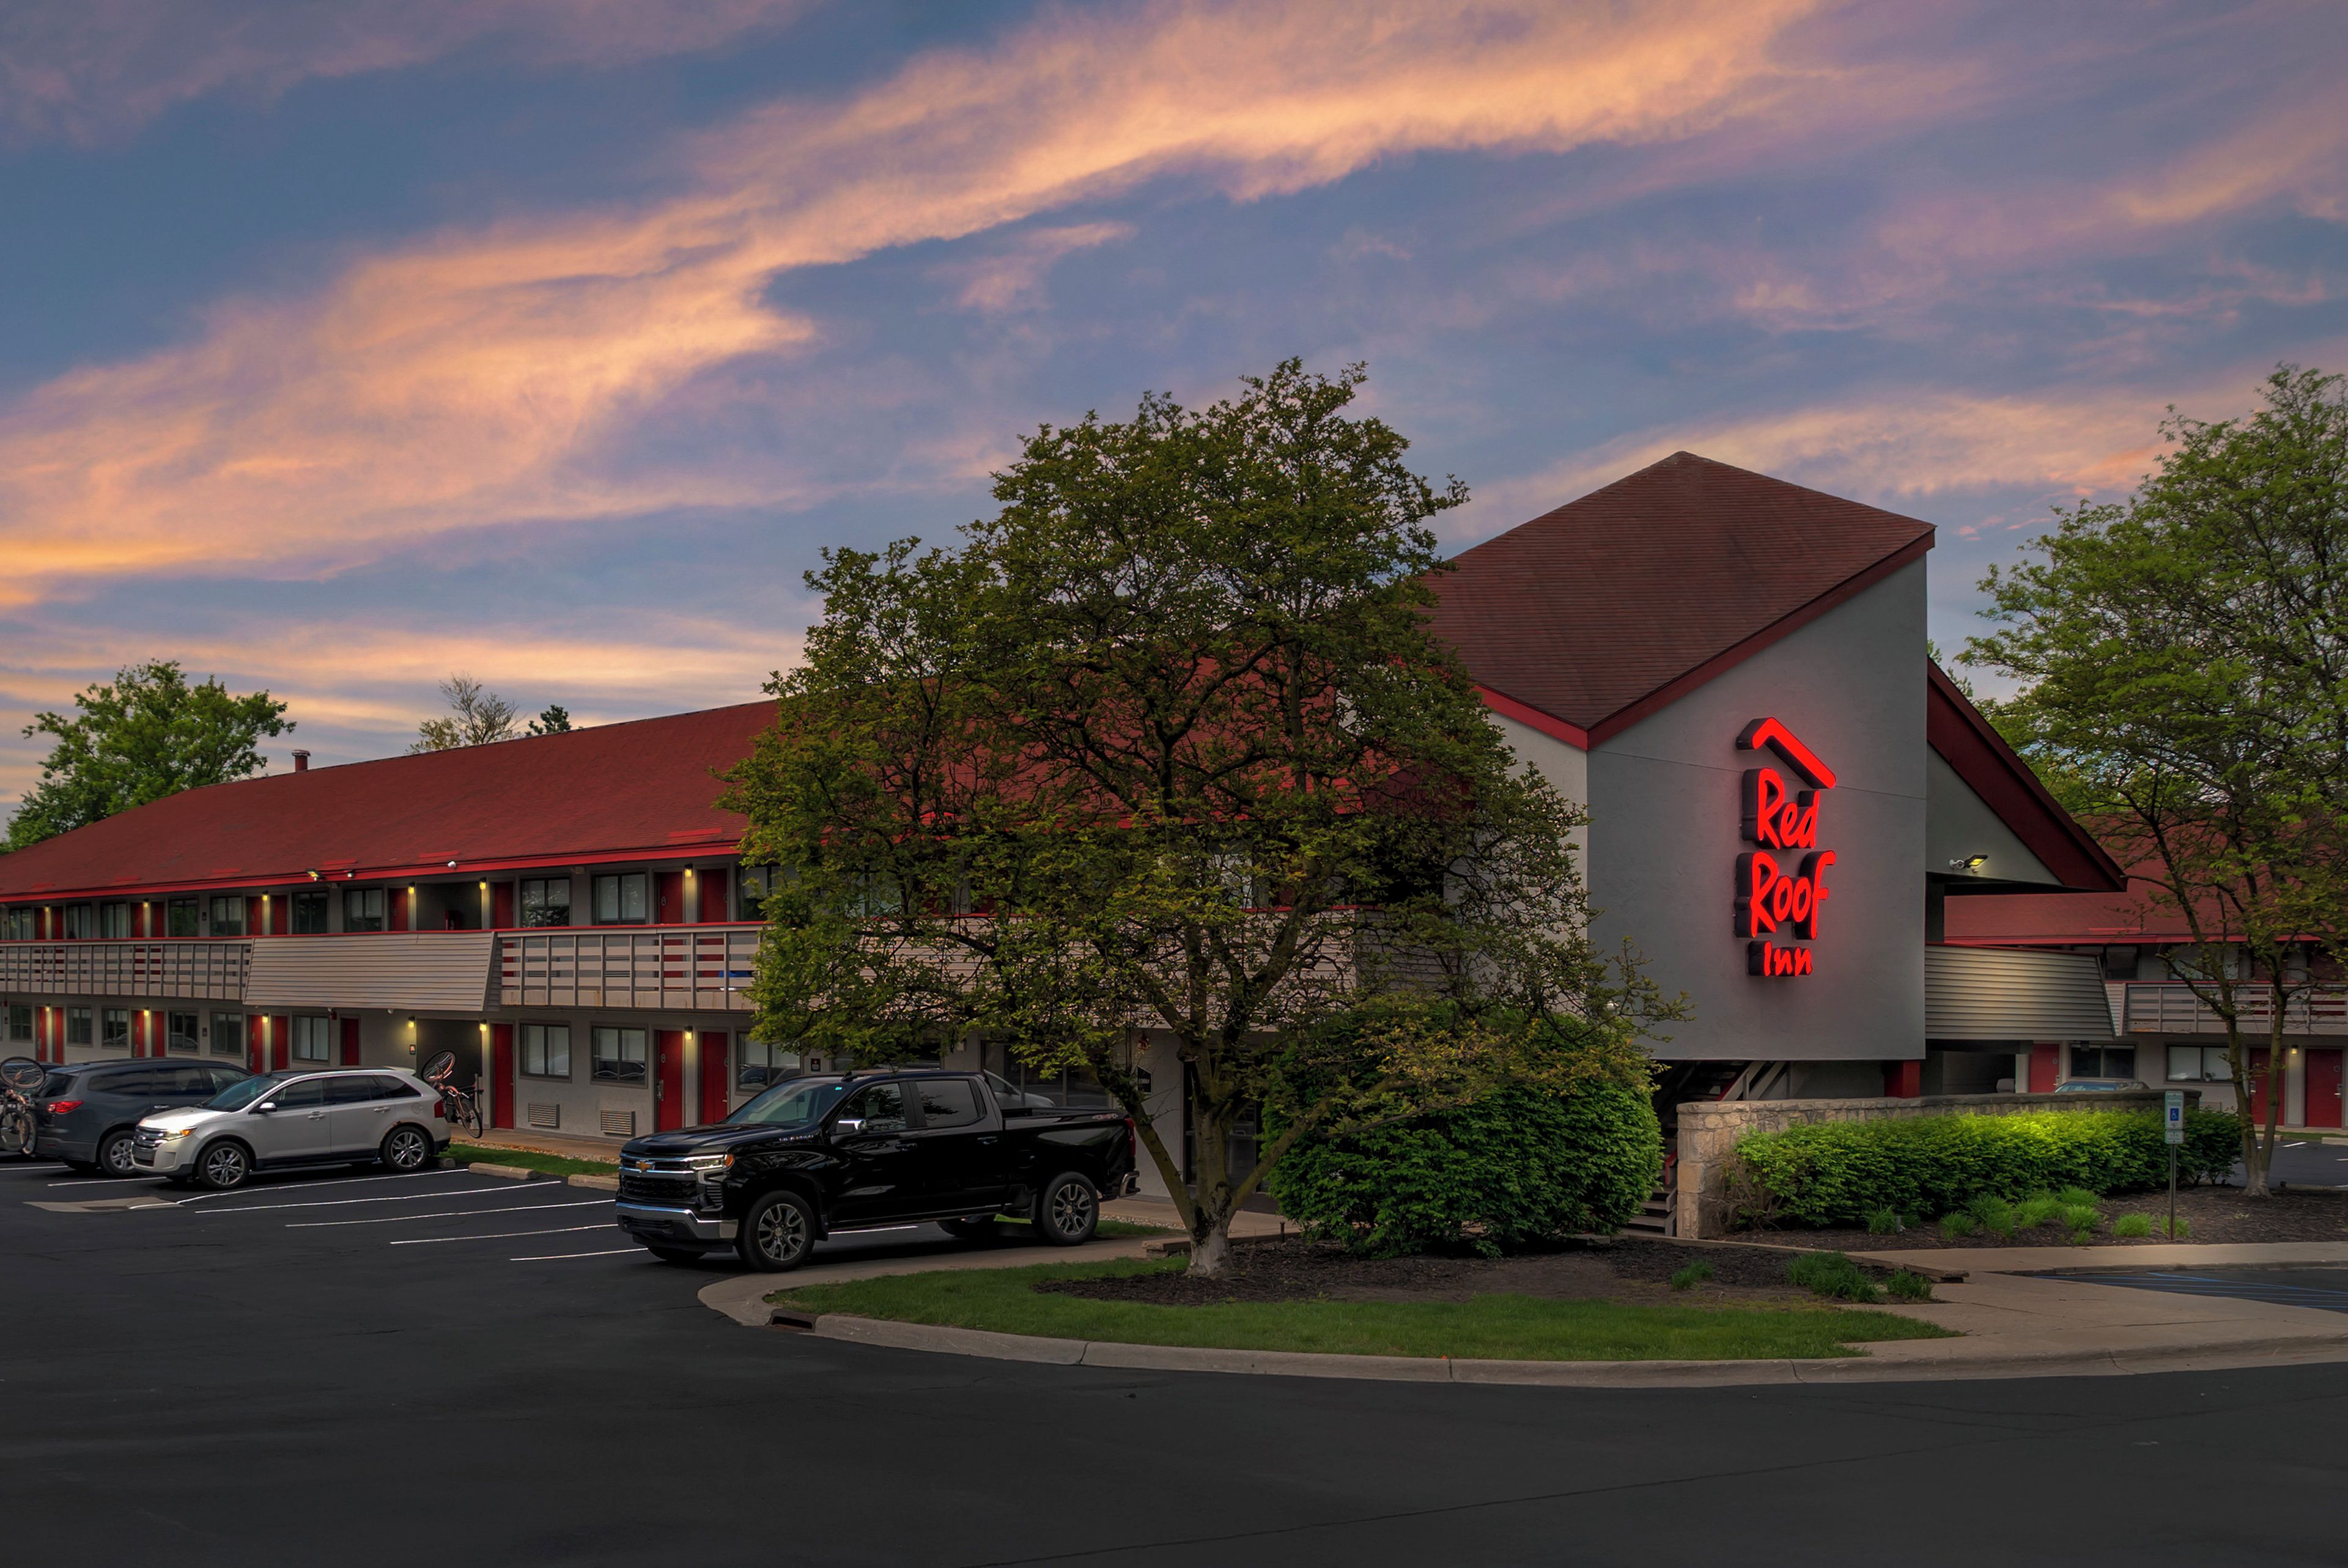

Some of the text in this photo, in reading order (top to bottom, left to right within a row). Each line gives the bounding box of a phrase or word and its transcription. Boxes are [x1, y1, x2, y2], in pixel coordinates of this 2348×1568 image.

[1757, 768, 1820, 849] Red
[1750, 850, 1836, 939] Roof
[1763, 941, 1812, 976] Inn
